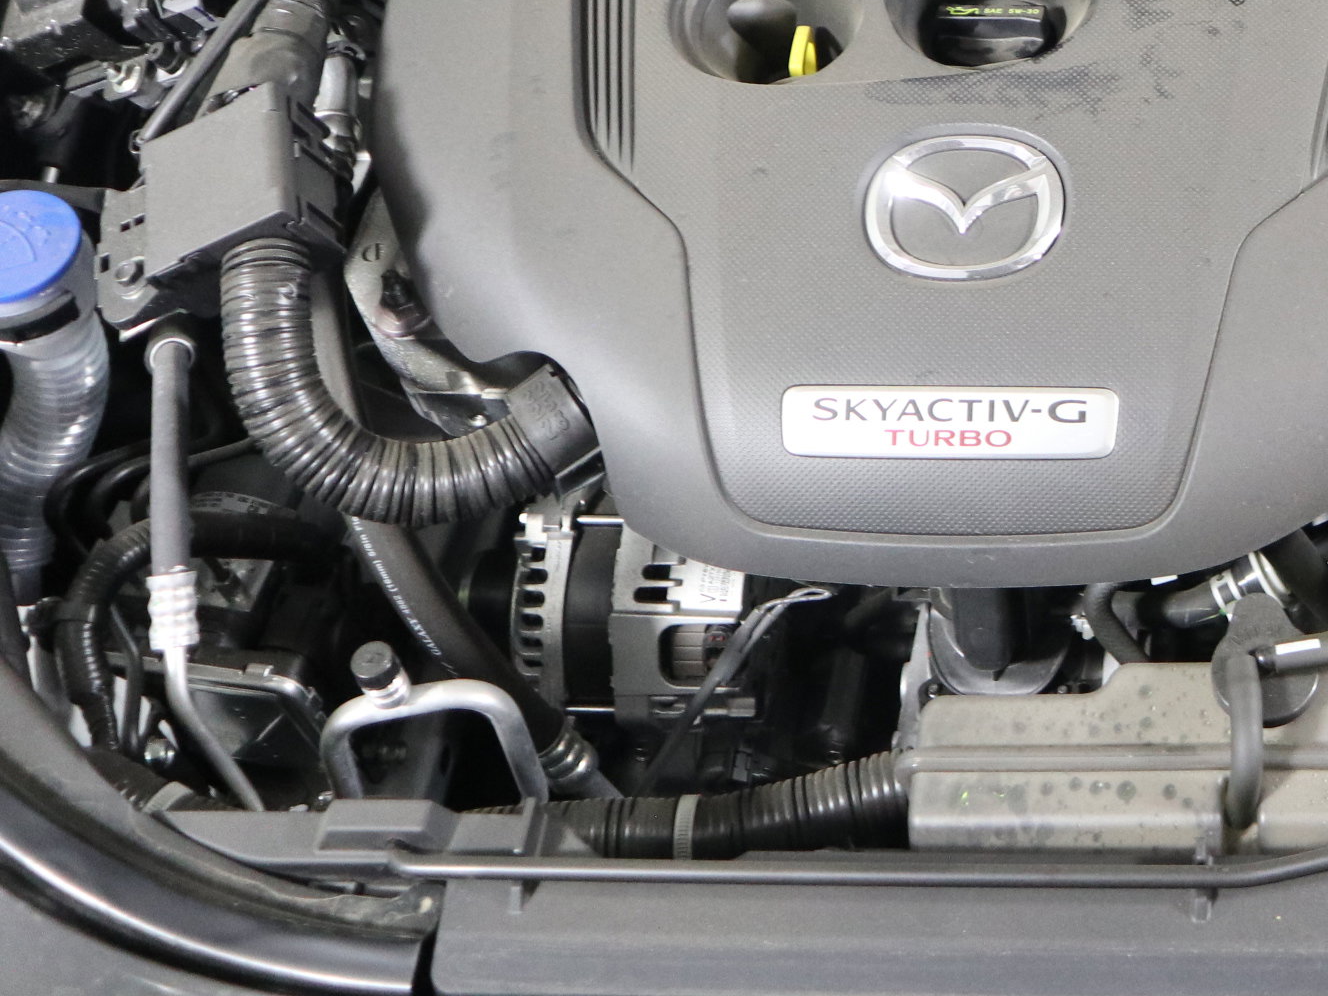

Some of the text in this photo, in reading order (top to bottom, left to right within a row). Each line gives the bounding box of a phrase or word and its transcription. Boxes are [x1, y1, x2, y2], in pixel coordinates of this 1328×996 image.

[1008, 7, 1040, 15] 5W-30
[812, 398, 1087, 423] SKYACTIV-G
[884, 429, 1012, 447] TURBO
[407, 616, 442, 656] GALAXY
